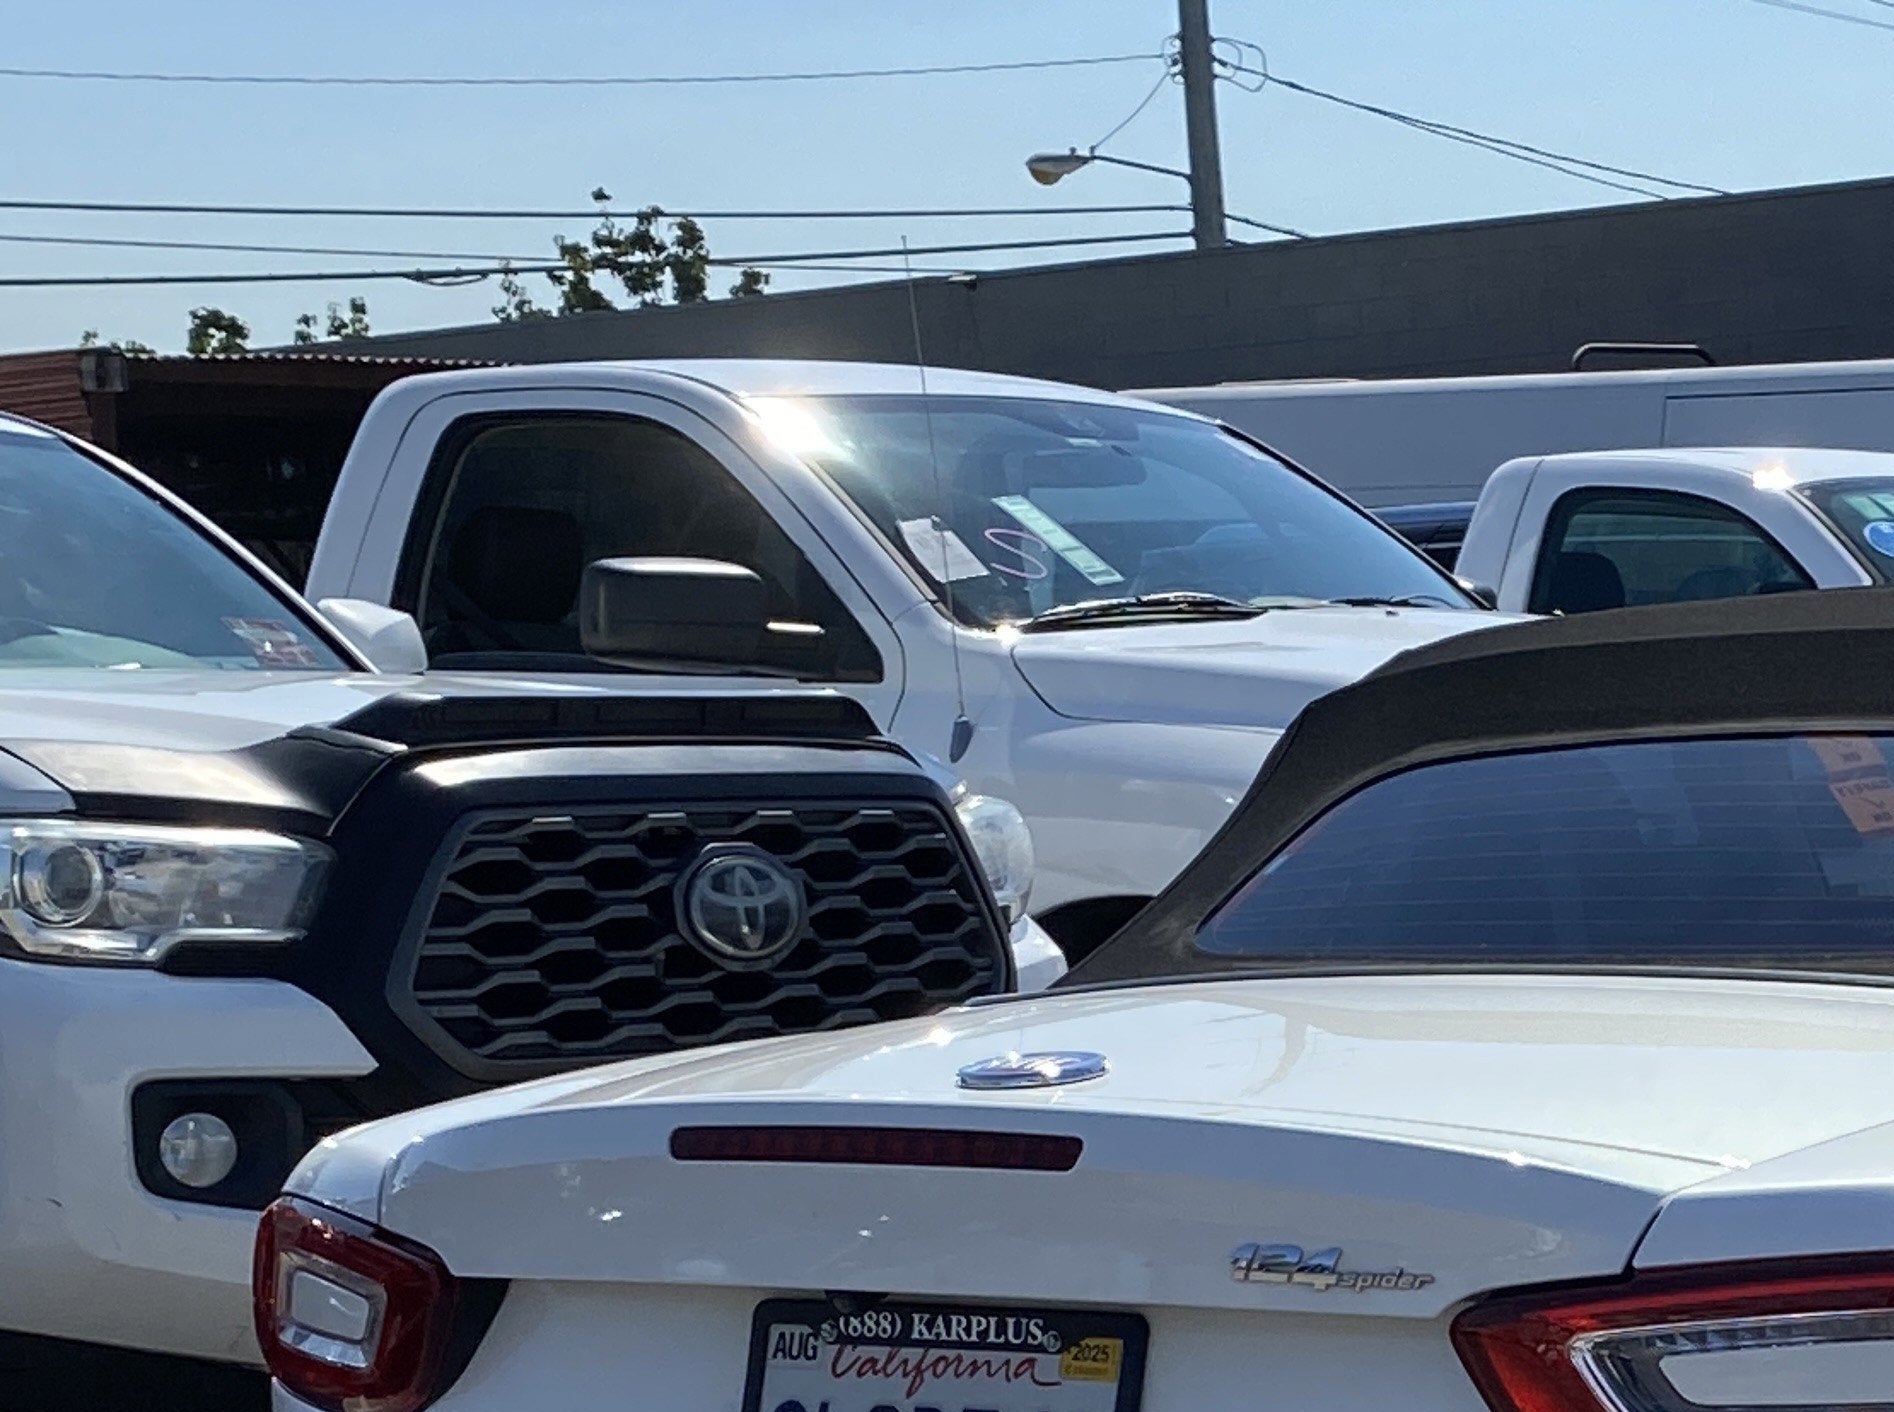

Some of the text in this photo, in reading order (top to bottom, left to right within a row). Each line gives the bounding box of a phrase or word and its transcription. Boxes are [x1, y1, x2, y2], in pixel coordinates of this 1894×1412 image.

[1231, 1243, 1435, 1294] 124 spider
[771, 1329, 820, 1361] AUG
[838, 1311, 1044, 1346] (888) KARPLUS
[1071, 1342, 1111, 1363] 2025
[829, 1343, 1062, 1400] California
